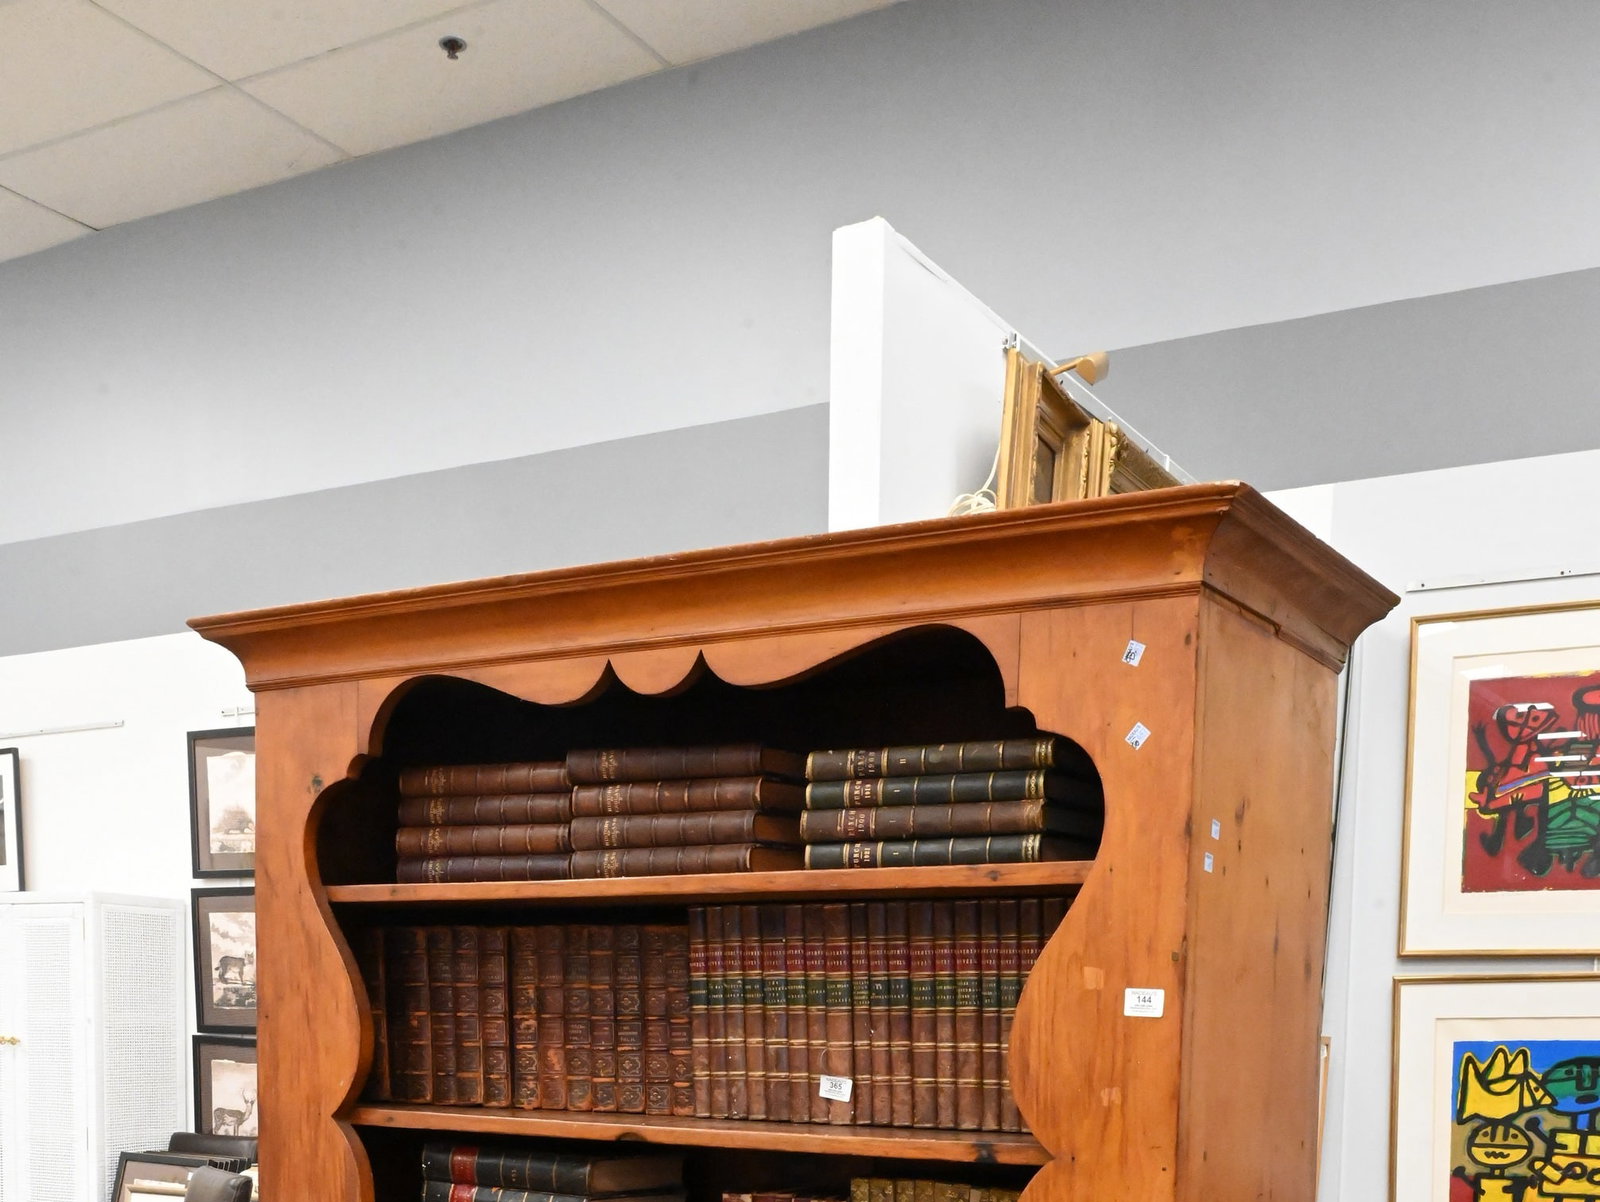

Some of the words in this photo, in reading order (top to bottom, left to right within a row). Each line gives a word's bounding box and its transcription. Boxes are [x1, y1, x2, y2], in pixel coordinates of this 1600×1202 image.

[853, 780, 863, 805] PUNCH
[847, 810, 857, 836] PUNCH
[1136, 995, 1153, 1004] 144
[829, 1081, 843, 1090] 365
